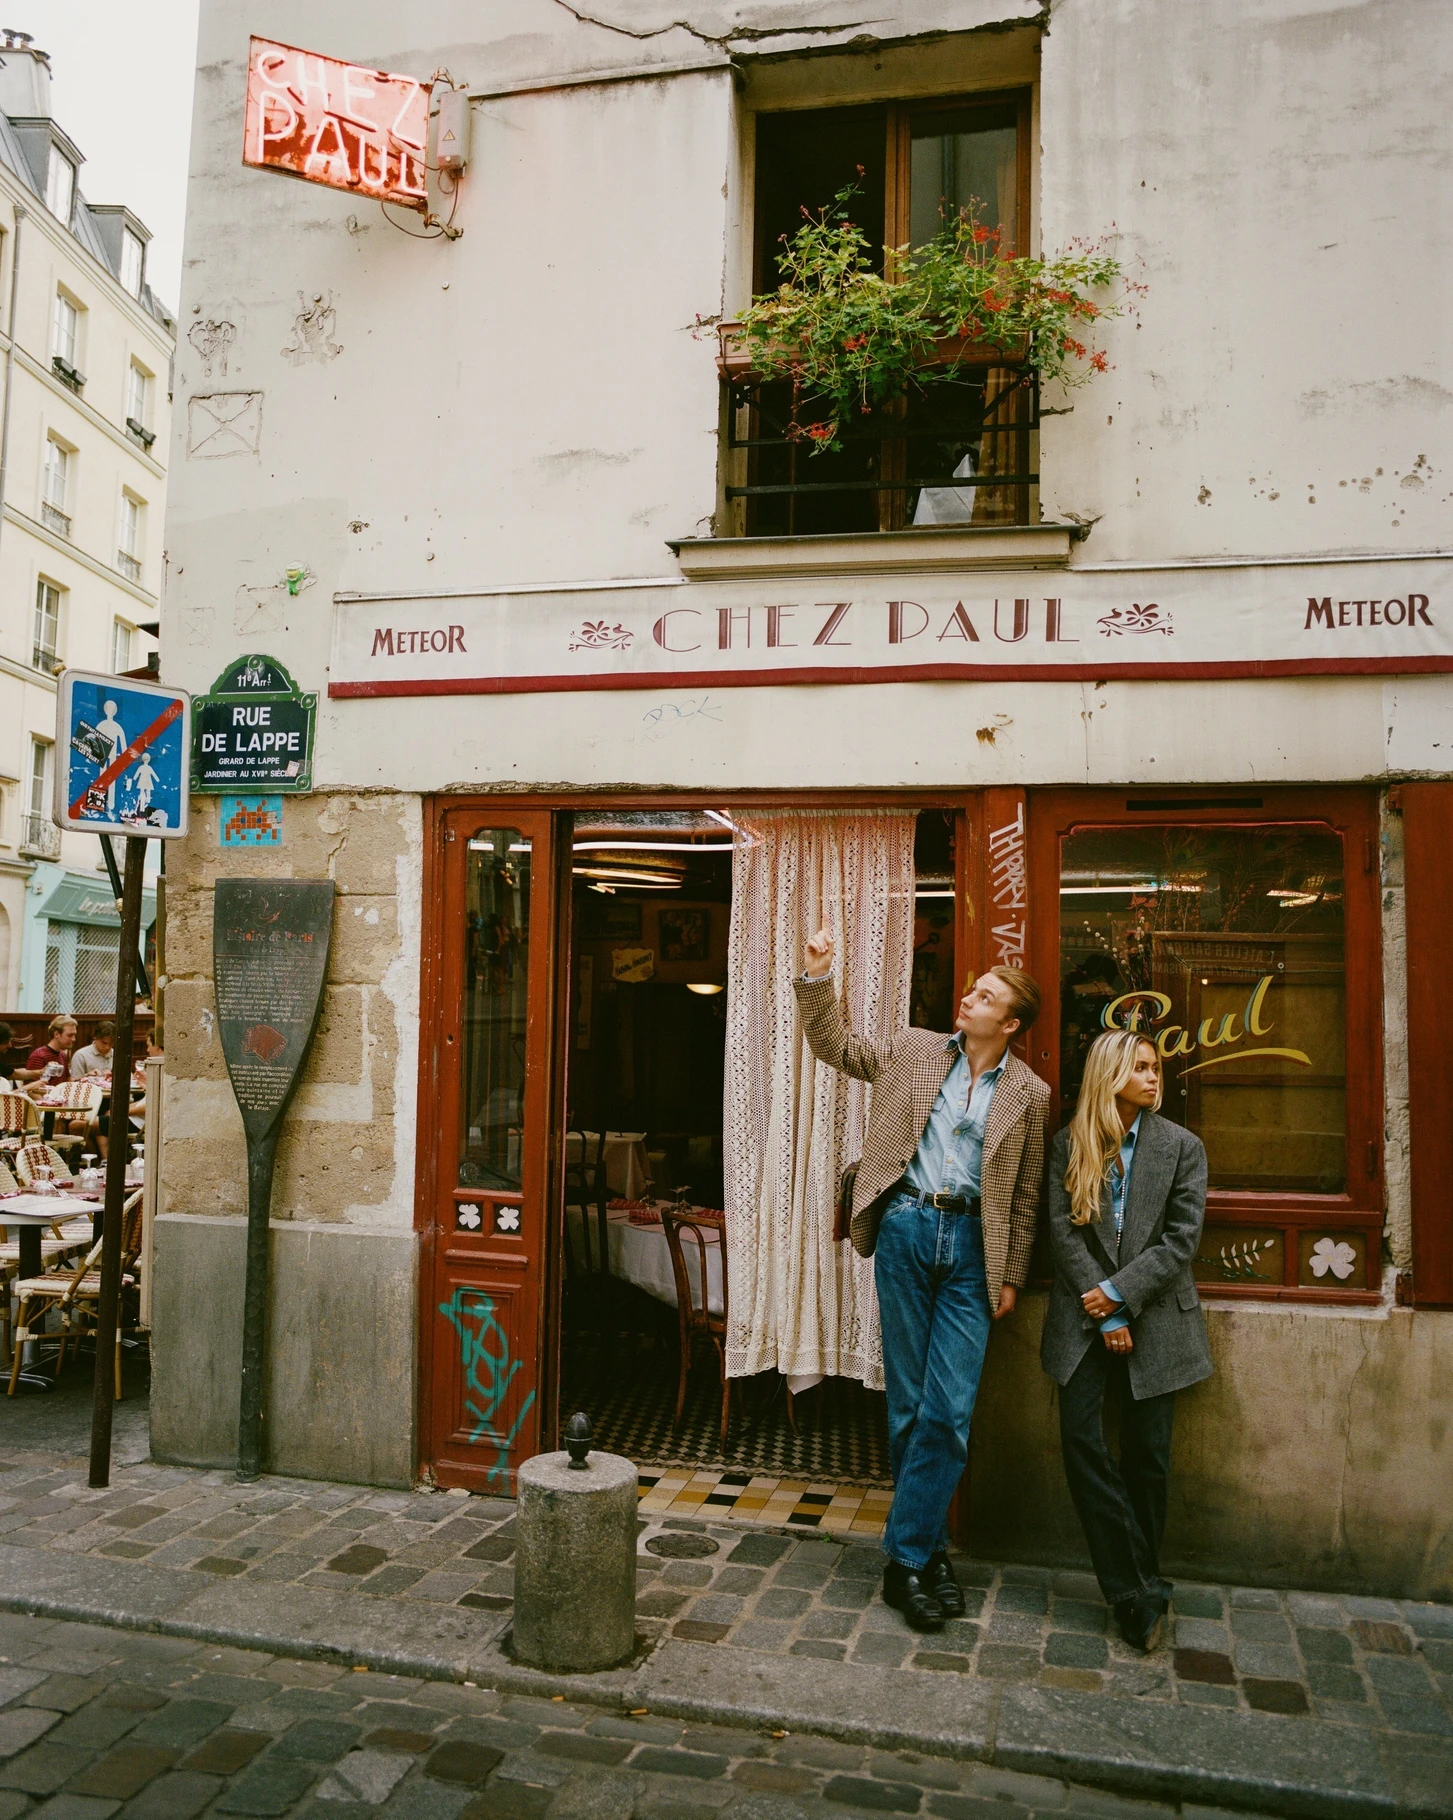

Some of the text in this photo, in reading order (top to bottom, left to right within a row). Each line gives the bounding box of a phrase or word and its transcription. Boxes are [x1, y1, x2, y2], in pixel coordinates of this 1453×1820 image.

[257, 50, 423, 150] CHEZ
[257, 90, 429, 198] PAUL
[652, 597, 1080, 653] CHEZ PAUL
[1304, 593, 1434, 630] METEOR
[371, 624, 468, 657] METEOR
[232, 706, 272, 727] RUE
[201, 731, 300, 753] DE LAPPE
[204, 770, 237, 778] JARDINIER
[239, 770, 249, 778] AU
[270, 768, 294, 778] SIÈC
[218, 757, 244, 766] GIRARD
[246, 757, 256, 765] DE
[257, 757, 280, 765] LAPPE
[1100, 975, 1275, 1060] Paul
